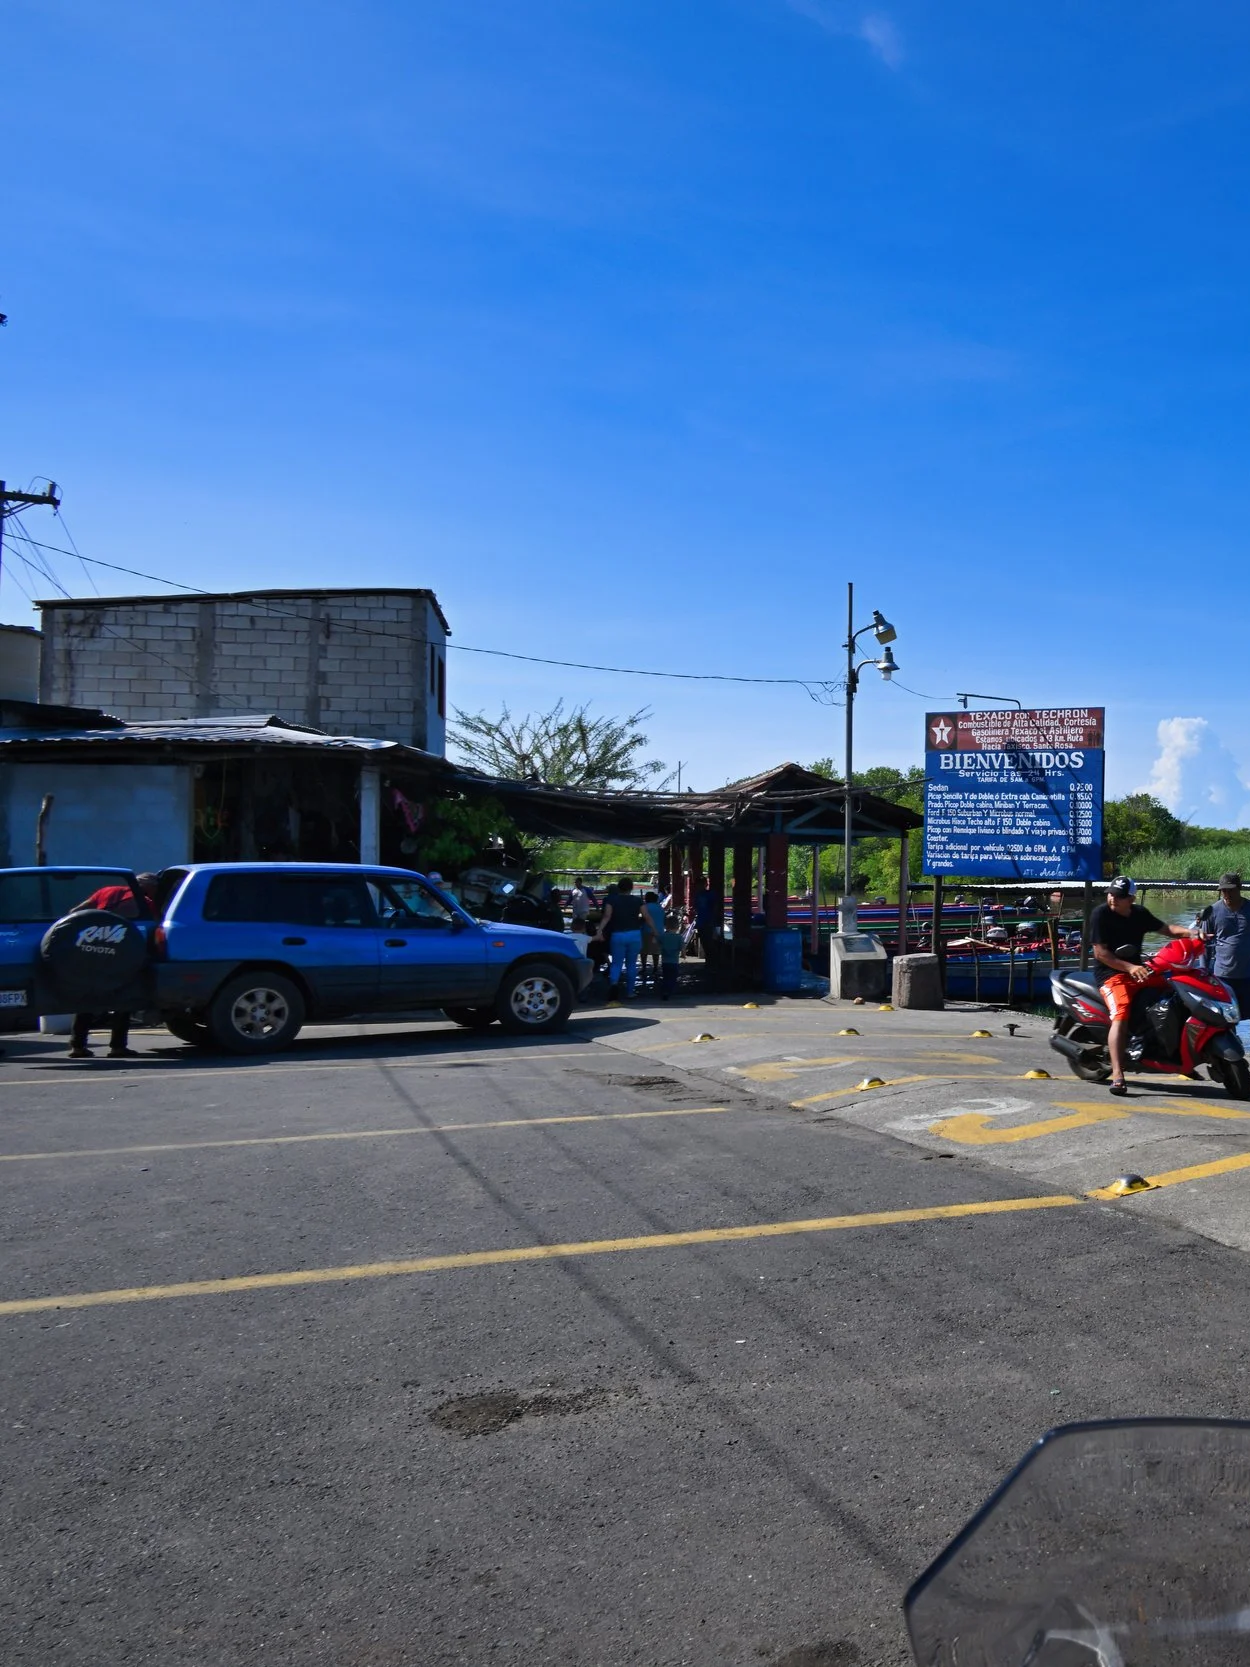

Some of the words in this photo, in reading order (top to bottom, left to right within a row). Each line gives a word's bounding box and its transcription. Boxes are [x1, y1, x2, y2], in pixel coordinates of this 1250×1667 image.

[970, 712, 1012, 720] TEXACO
[1035, 709, 1088, 719] TECHRON
[958, 720, 1002, 728] Combustible
[1013, 719, 1028, 727] Alta
[1064, 717, 1096, 726] Cortesía
[971, 728, 1009, 736] Gasolinera
[940, 752, 1084, 769] BIENVENIDOS
[944, 800, 959, 809] Picop
[927, 826, 941, 834] Picop
[953, 826, 977, 835] Remolque
[1031, 828, 1046, 836] viaje
[1048, 828, 1068, 836] privado
[982, 843, 1004, 851] vehículo
[980, 853, 992, 861] para
[1020, 854, 1061, 864] sobrecargados
[76, 924, 128, 946] RAV4
[81, 944, 116, 955] TOYOTA
